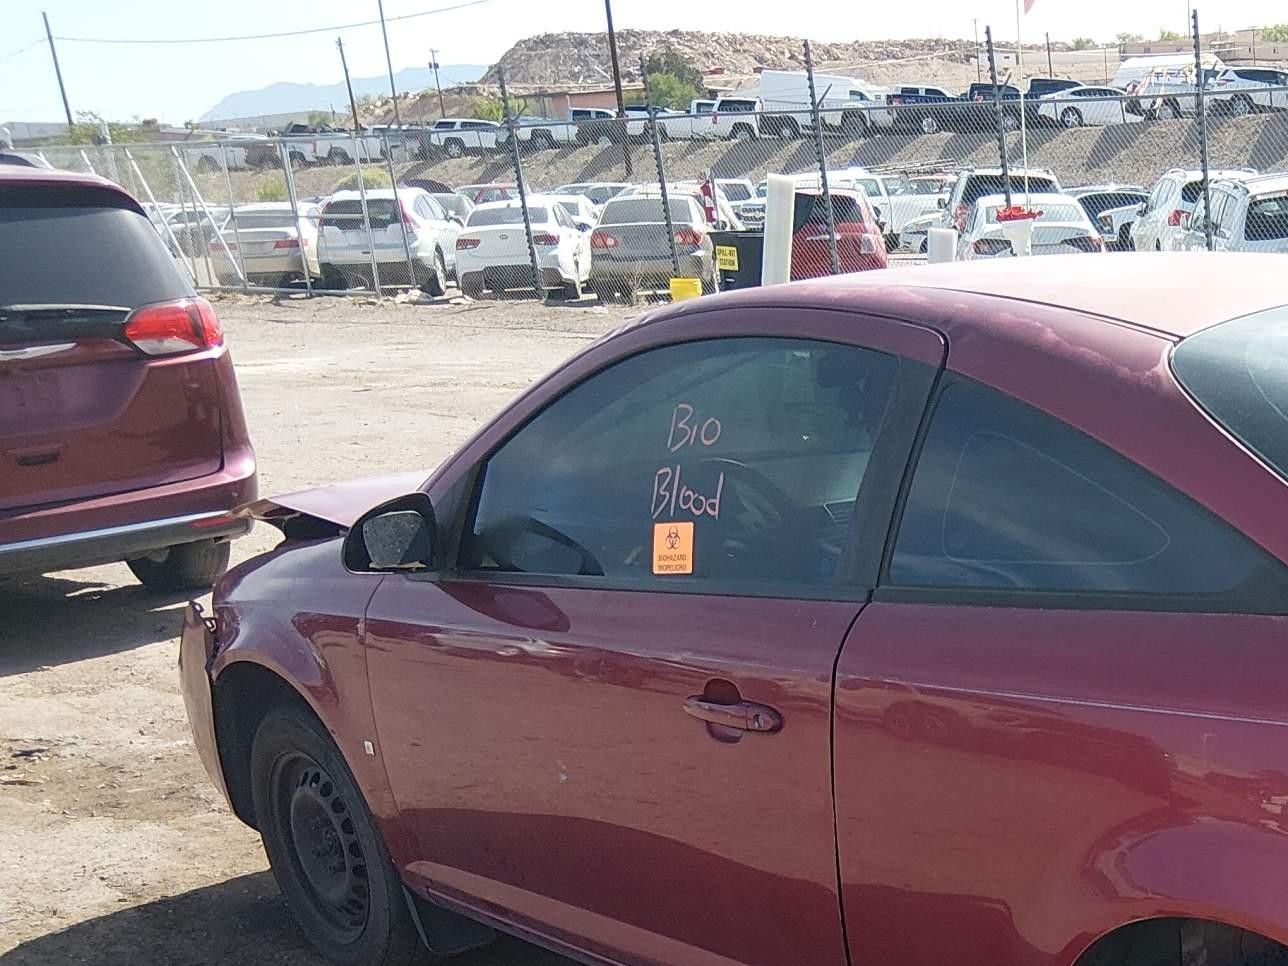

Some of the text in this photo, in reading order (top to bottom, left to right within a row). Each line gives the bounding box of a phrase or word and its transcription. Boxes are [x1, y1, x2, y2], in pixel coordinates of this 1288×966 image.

[719, 258, 736, 266] STATION
[651, 464, 724, 520] Blood
[658, 554, 687, 562] BIOHAZARD
[658, 564, 687, 572] BIOPELIGRO
